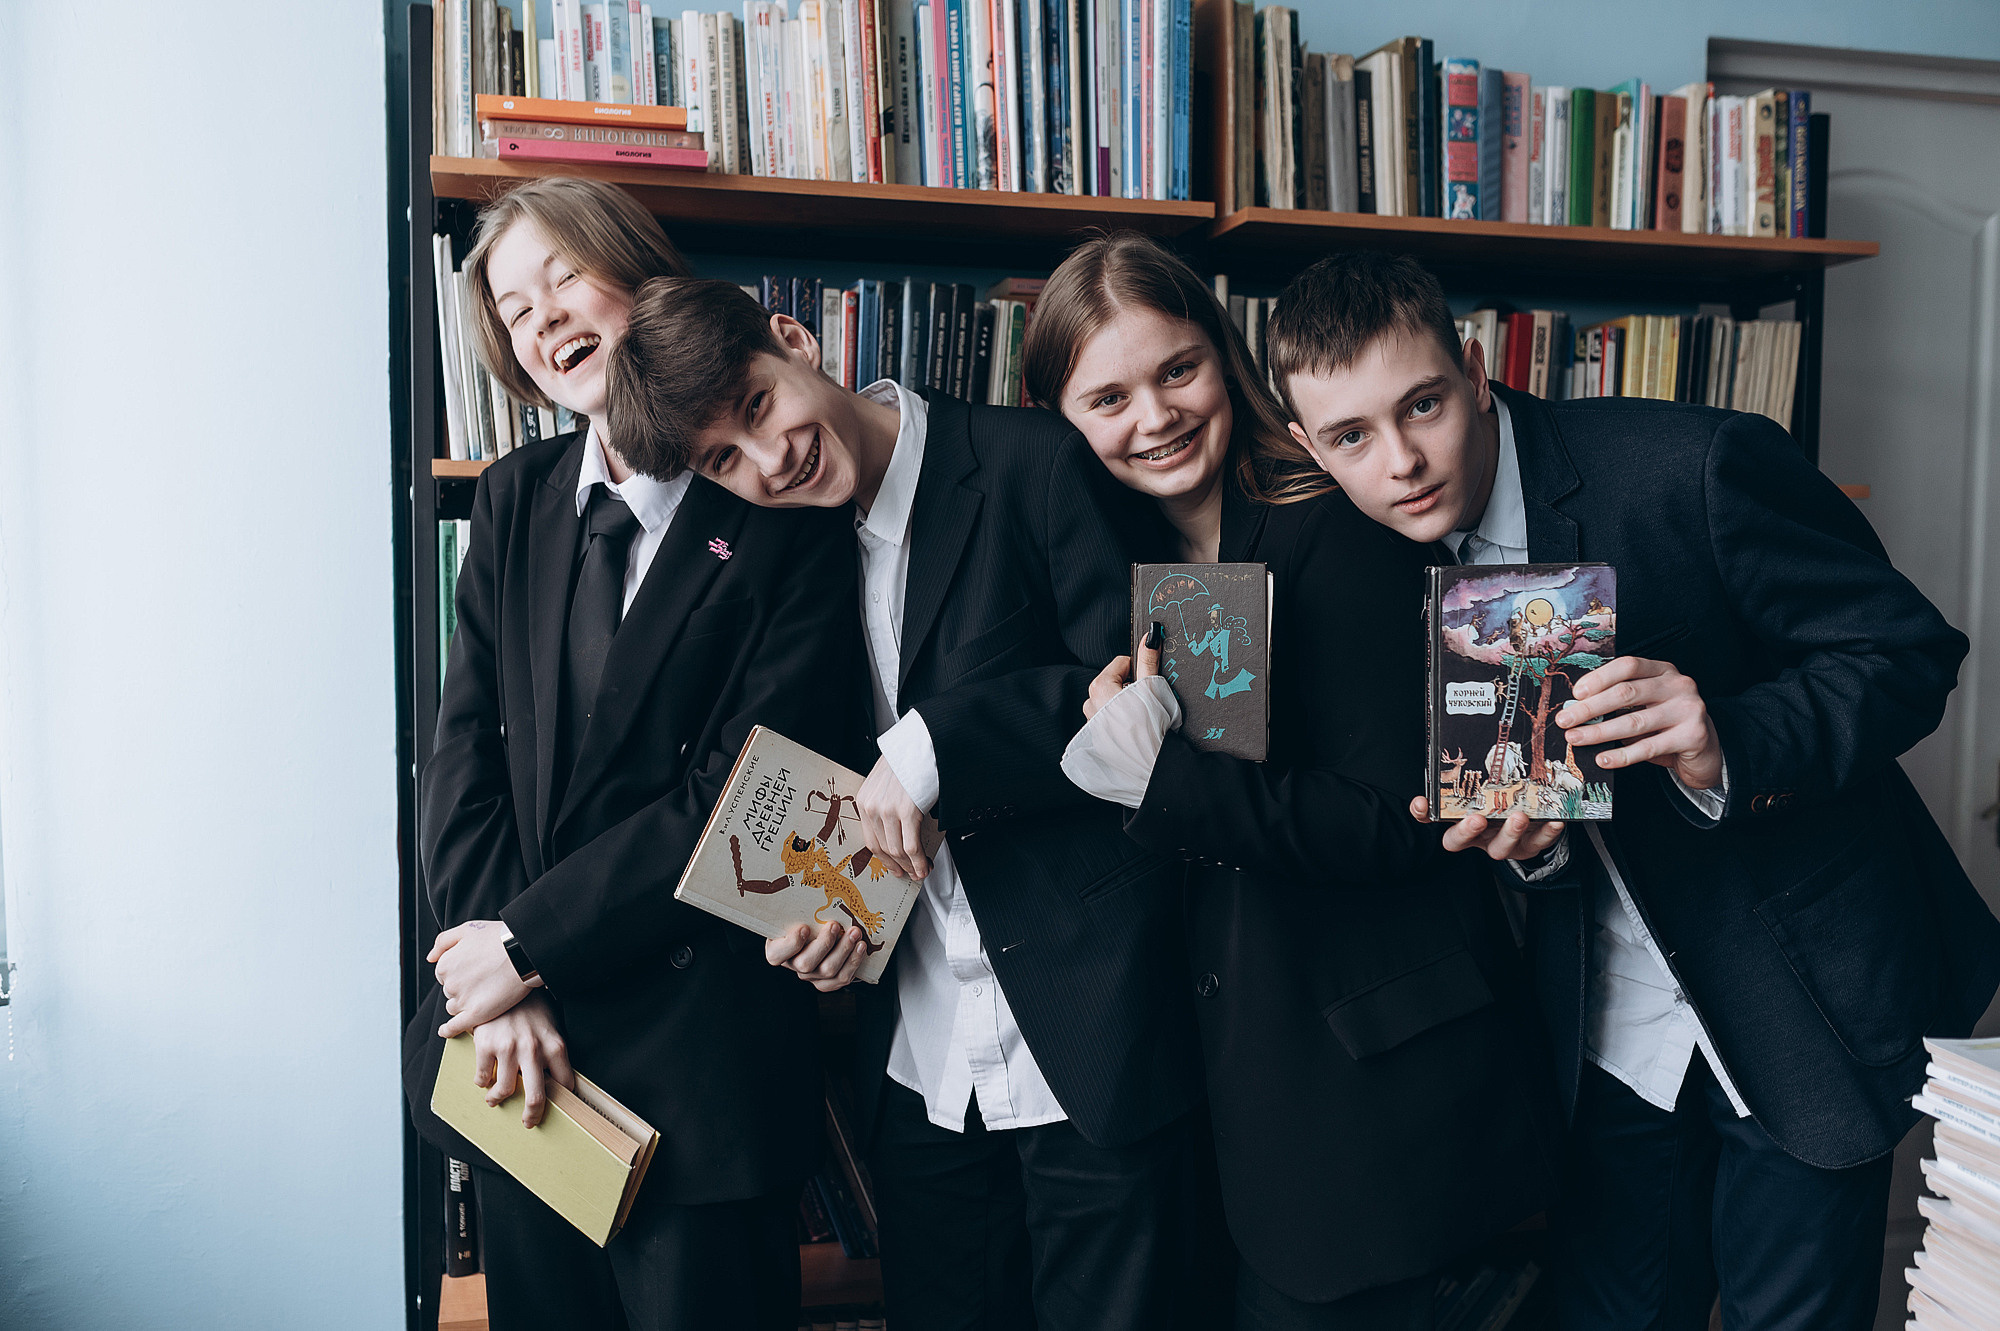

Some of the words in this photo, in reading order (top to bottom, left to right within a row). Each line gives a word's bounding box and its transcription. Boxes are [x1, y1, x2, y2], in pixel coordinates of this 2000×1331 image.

[950, 9, 960, 50] ГОРОДА
[503, 101, 515, 110] 8
[951, 51, 962, 126] ИЗУМРУДНОГО
[594, 107, 632, 116] БИОЛОГИЯ
[544, 127, 565, 140] 8
[574, 127, 668, 147] БИОЛОГИЯ
[615, 150, 652, 158] БИОЛОГИЯ
[1448, 698, 1492, 707] ЧУКОВСКИЙ
[728, 755, 760, 814] УСПЕНСКИЕ
[743, 775, 773, 831] МИФЫ
[752, 767, 791, 844] ДРЕВНЕЙ
[760, 786, 797, 852] ГРЕЦИИ
[449, 1157, 462, 1192] ВЛАСТЕ
